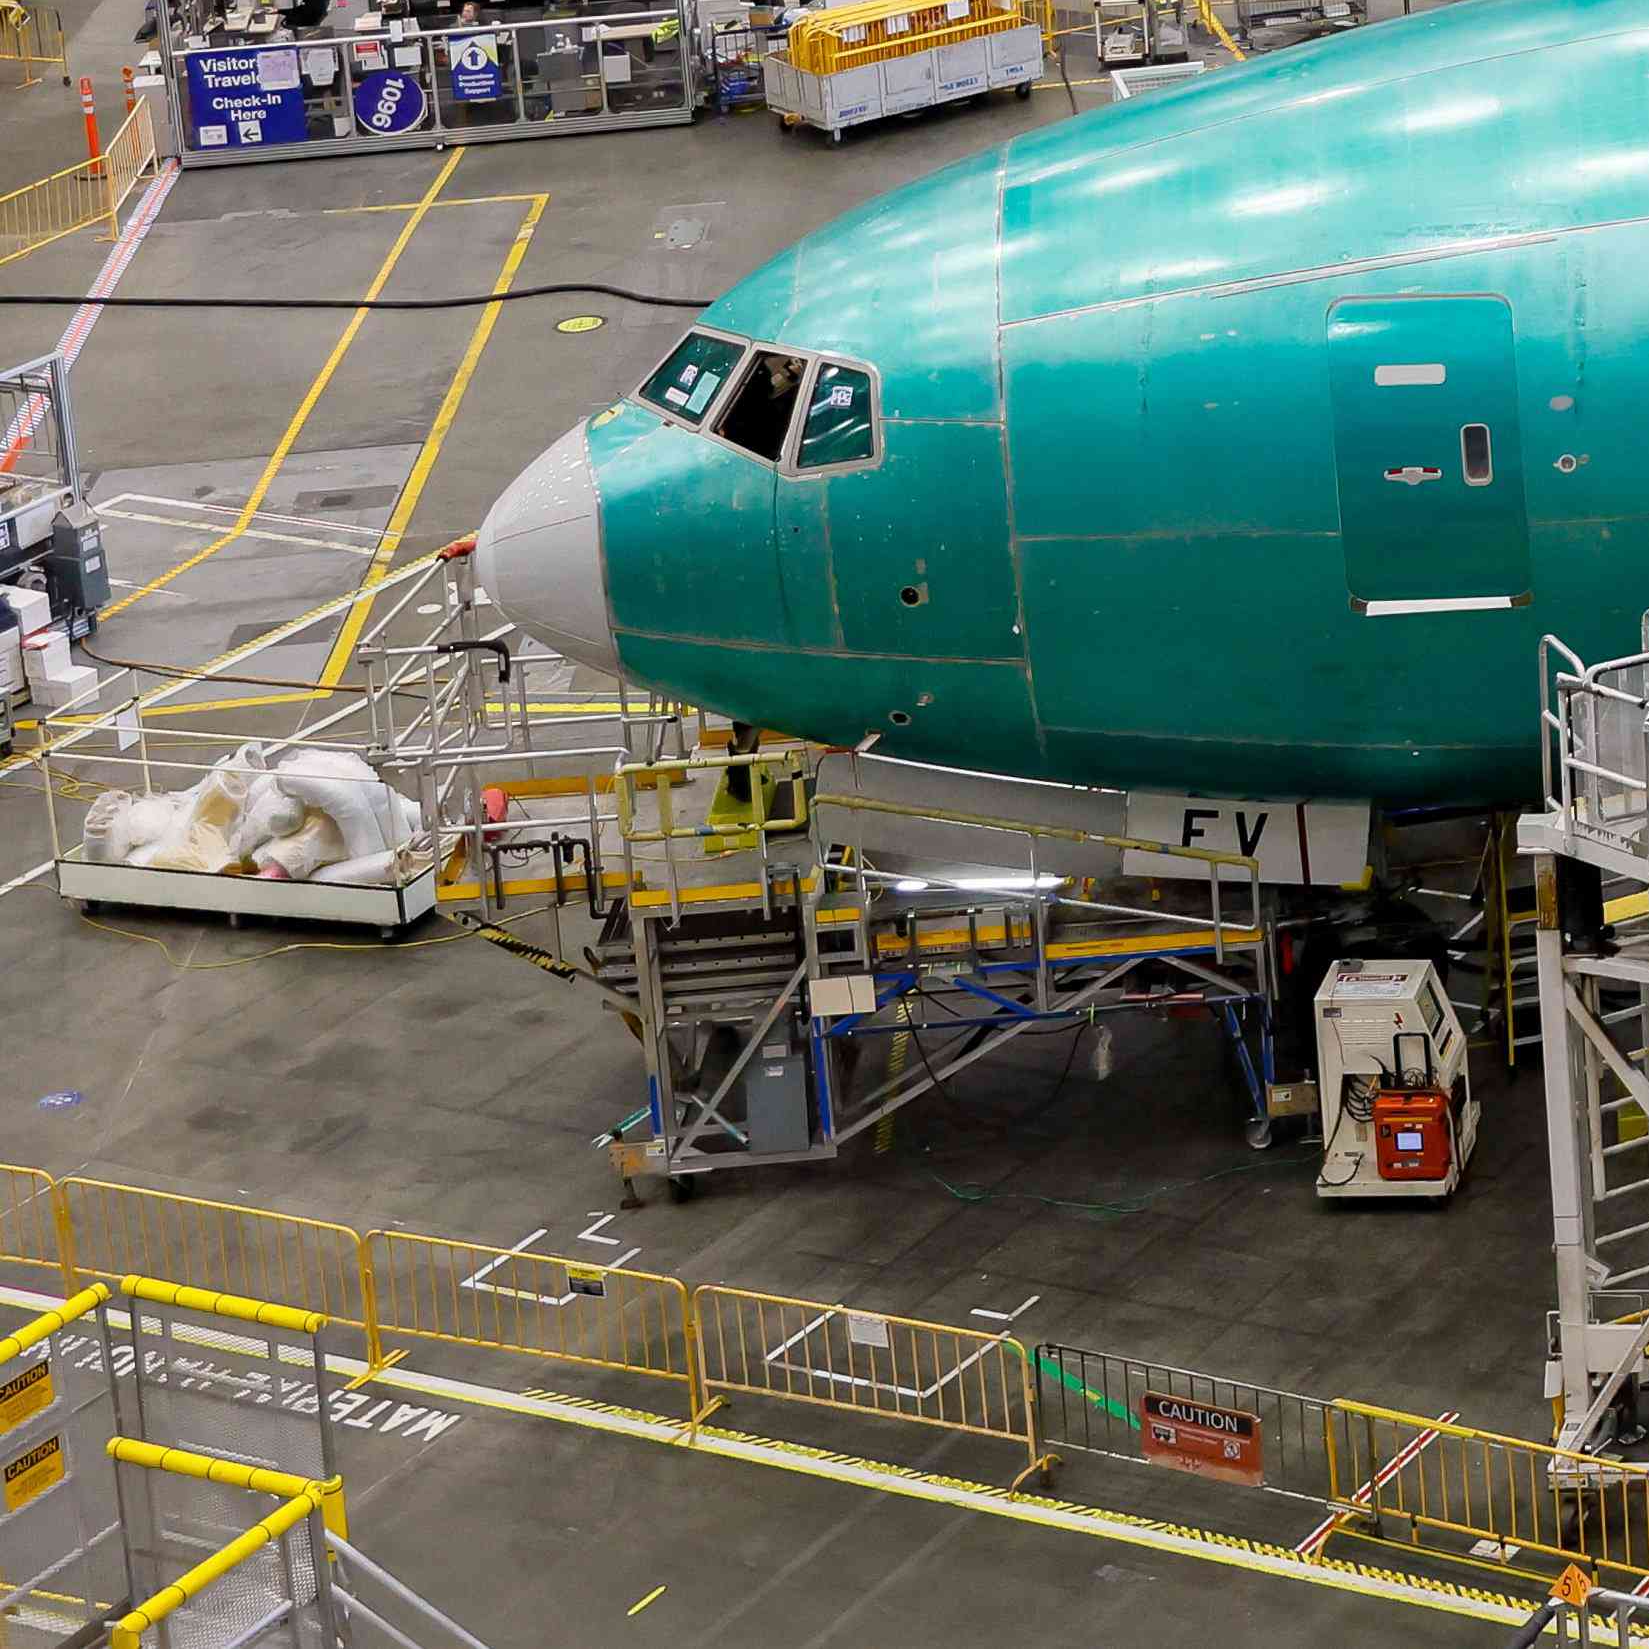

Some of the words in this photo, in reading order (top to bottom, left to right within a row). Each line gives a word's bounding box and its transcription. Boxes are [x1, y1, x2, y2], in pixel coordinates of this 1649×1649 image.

[199, 56, 260, 73] Visitor
[212, 93, 281, 110] Check-In
[231, 109, 267, 121] Here
[372, 77, 405, 128] 1096
[0, 1362, 49, 1402] CAUTION
[1159, 1401, 1239, 1432] CAUTION
[7, 1438, 59, 1480] CAUTION
